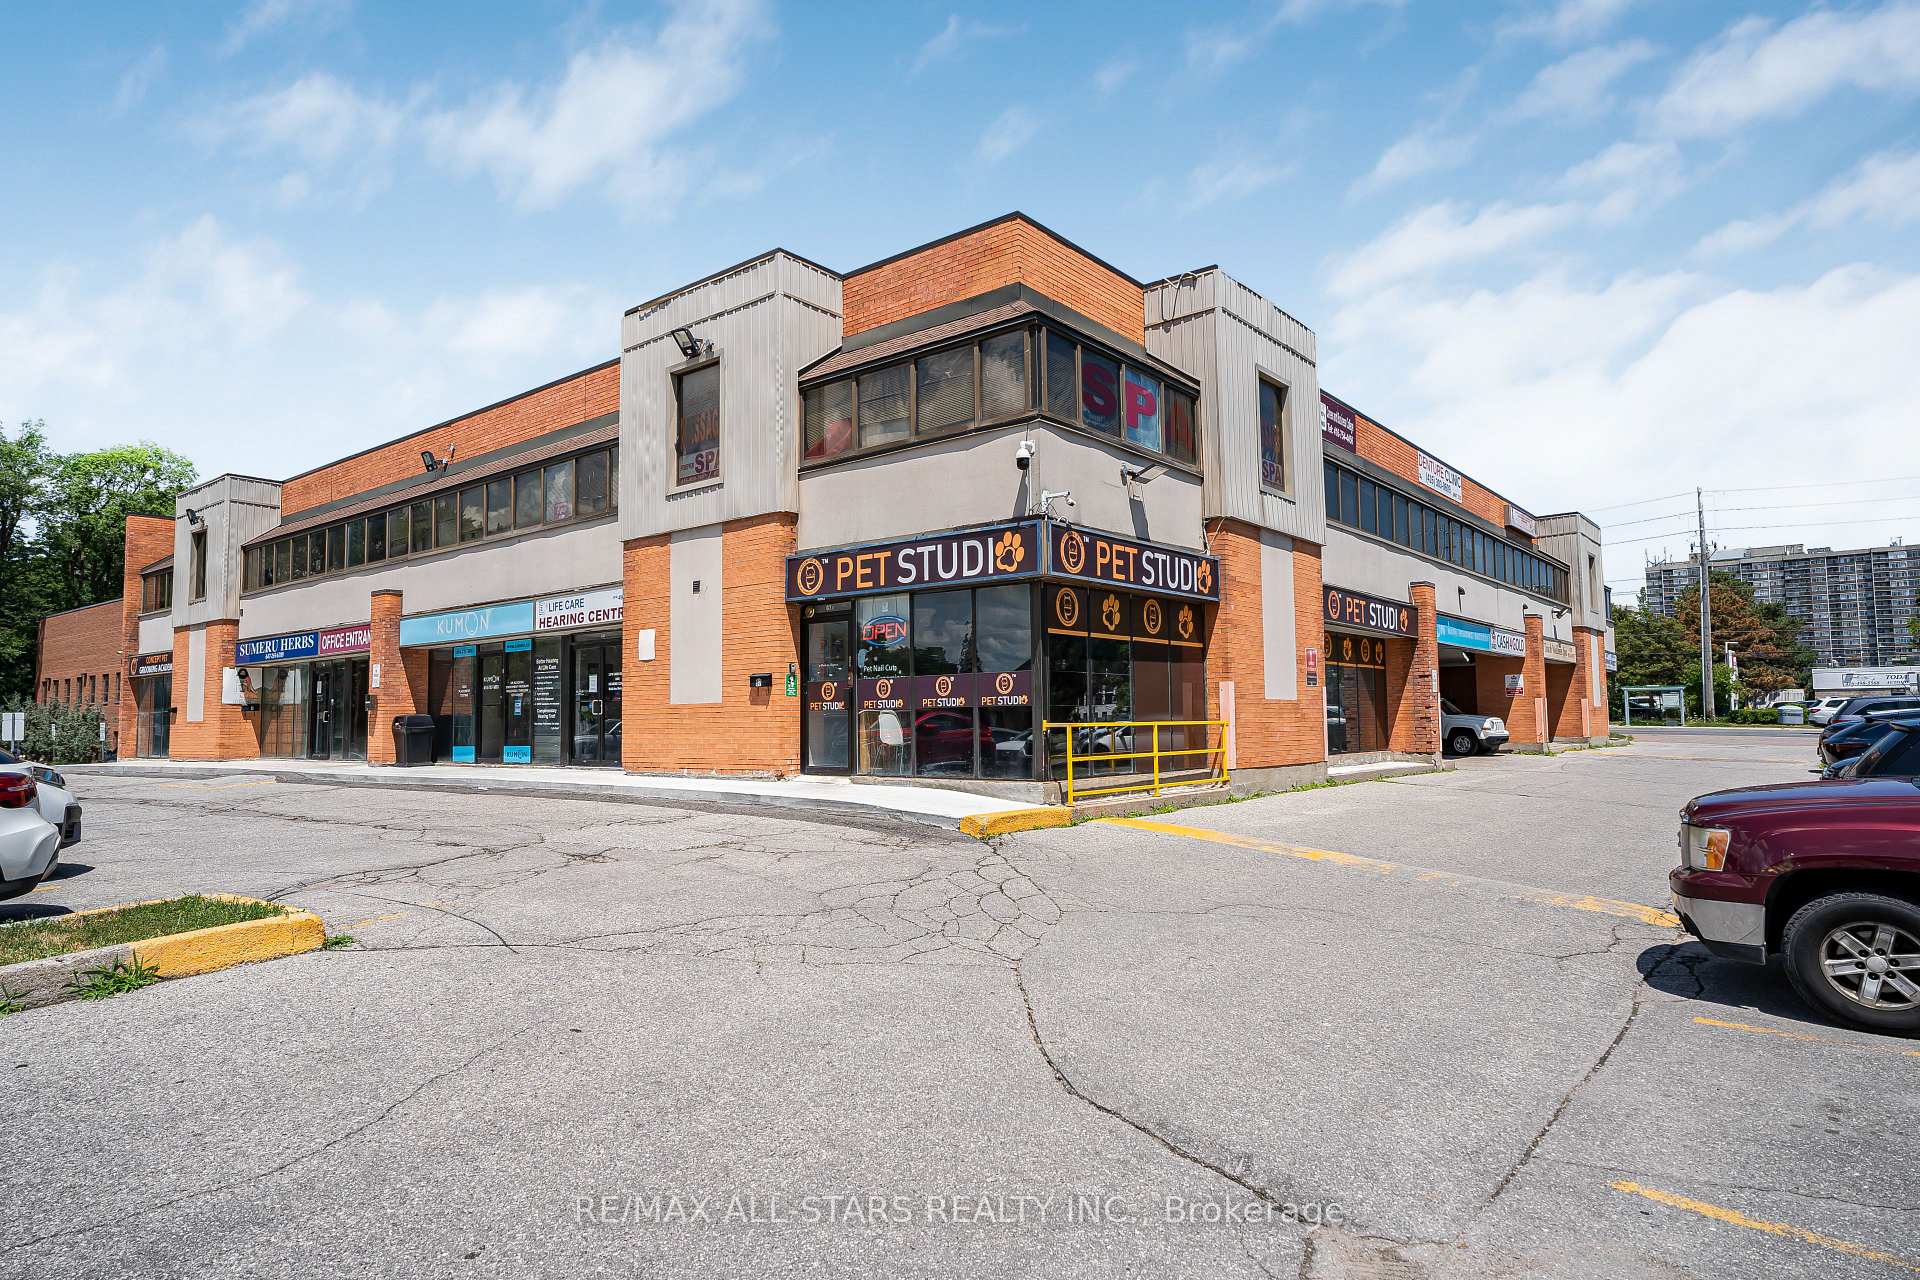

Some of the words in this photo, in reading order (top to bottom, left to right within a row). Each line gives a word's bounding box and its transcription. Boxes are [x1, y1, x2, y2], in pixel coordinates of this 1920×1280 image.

[1418, 453, 1445, 479] DENTURE
[1445, 469, 1461, 489] CLINIC
[1096, 540, 1138, 582] PET
[836, 551, 893, 591] PET
[548, 600, 564, 613] LIFE
[565, 597, 585, 610] CARE
[1345, 597, 1367, 625] PET
[437, 611, 489, 636] KUMON
[538, 611, 587, 629] HEARING
[862, 622, 907, 641] OPEN
[239, 639, 279, 657] SUMERU
[280, 634, 315, 651] HERBS
[321, 634, 345, 650] OFFICE
[810, 702, 822, 711] PET
[863, 700, 877, 709] PET
[922, 698, 937, 708] PET
[981, 697, 997, 706] PET
